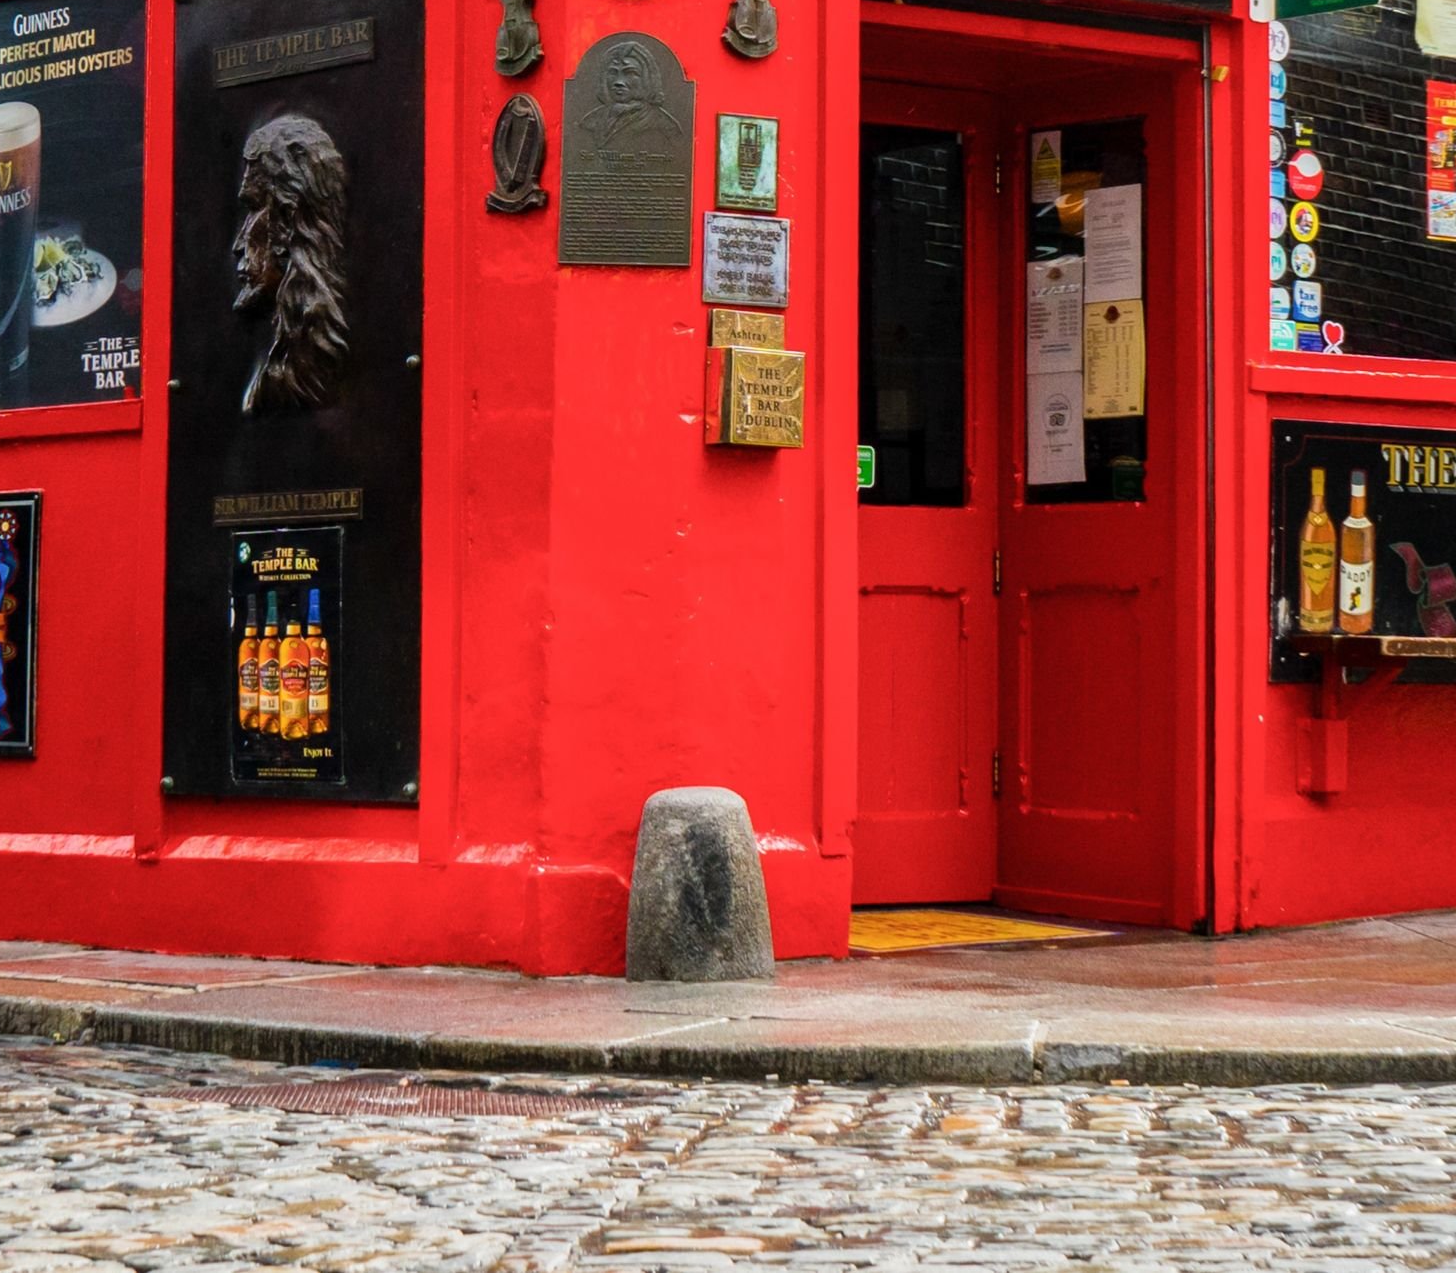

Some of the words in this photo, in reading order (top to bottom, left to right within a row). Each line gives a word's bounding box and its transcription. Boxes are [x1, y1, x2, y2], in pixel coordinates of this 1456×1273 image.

[13, 6, 71, 37] GUINNESS
[0, 38, 52, 65] PERFECT
[52, 28, 96, 54] MATCH
[215, 44, 249, 70] THE
[255, 30, 326, 63] TEMPLE
[330, 21, 369, 48] BAR
[43, 57, 76, 81] IRISH
[78, 46, 134, 74] OYSTERS
[1298, 288, 1316, 302] tax
[1298, 301, 1319, 314] free
[730, 330, 768, 343] Ashtray
[98, 337, 123, 352] THE
[80, 349, 141, 373] TEMPLE
[95, 370, 125, 389] BAR
[757, 368, 782, 380] THE
[746, 384, 794, 397] TEMPLE
[757, 399, 781, 412] BAR
[744, 414, 794, 428] DUBLIN
[275, 547, 294, 558] THE
[251, 558, 293, 574] TEMPLE
[295, 557, 319, 572] BAR
